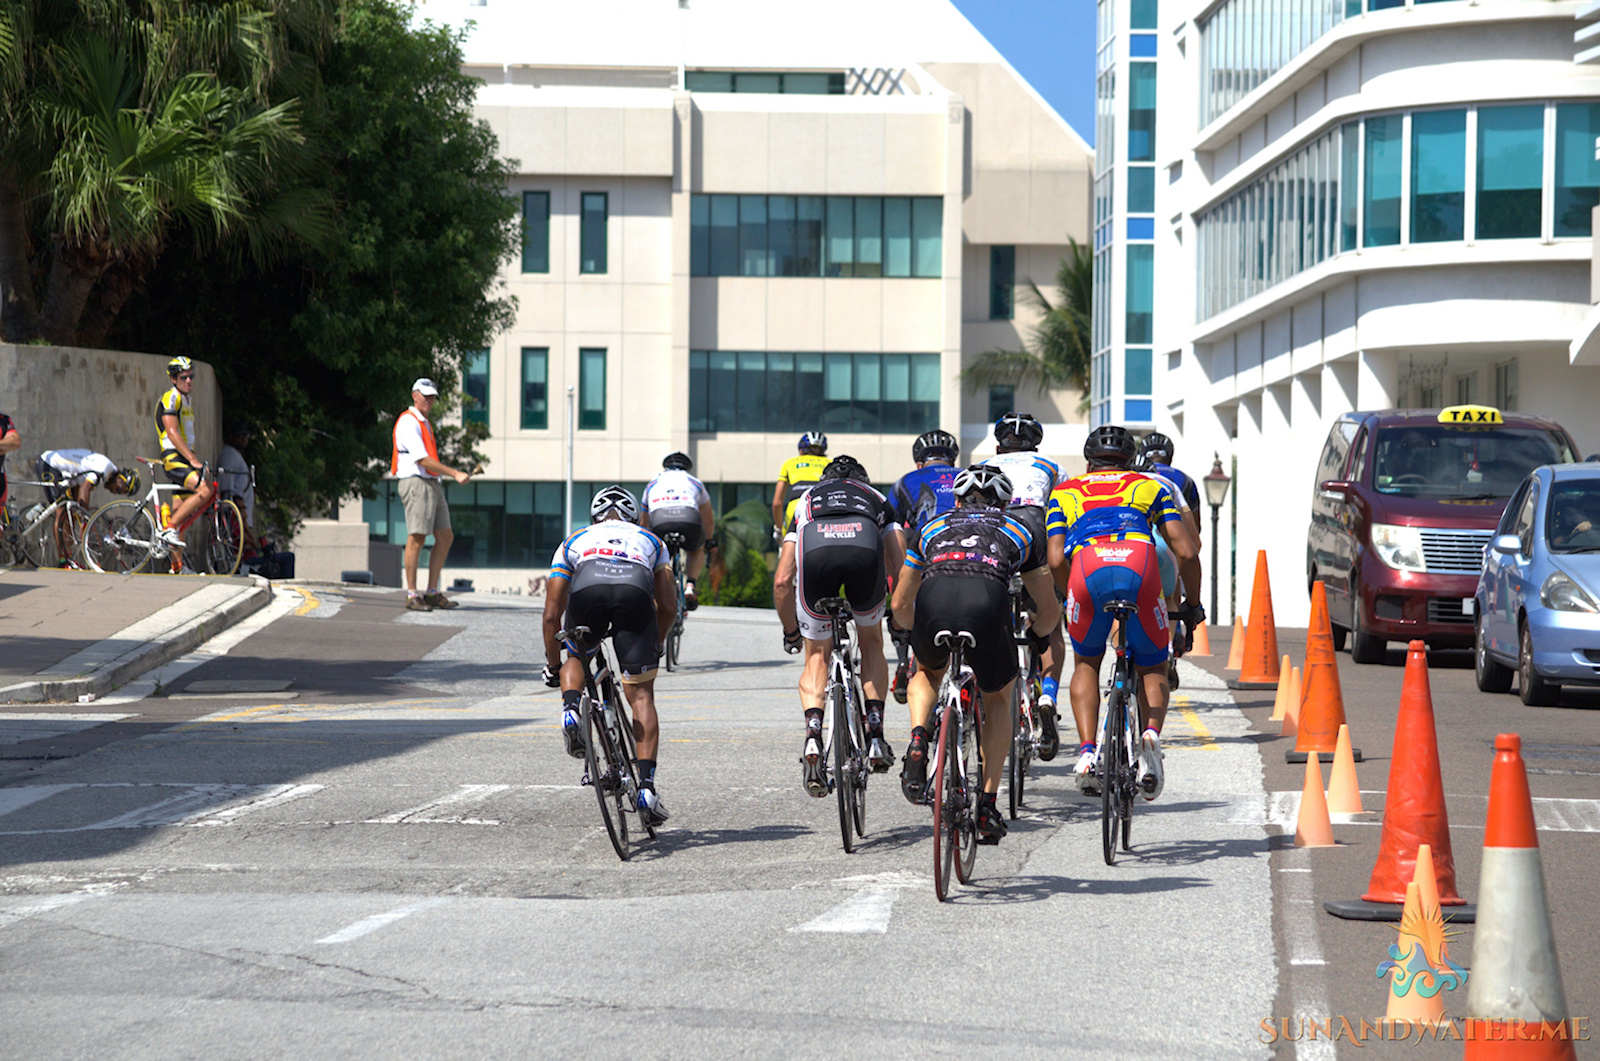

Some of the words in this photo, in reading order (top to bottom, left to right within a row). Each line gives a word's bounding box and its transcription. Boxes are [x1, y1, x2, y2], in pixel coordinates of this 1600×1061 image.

[1450, 411, 1495, 421] TAXI
[817, 523, 863, 533] LANDRY'S
[824, 531, 857, 539] BICYCLES
